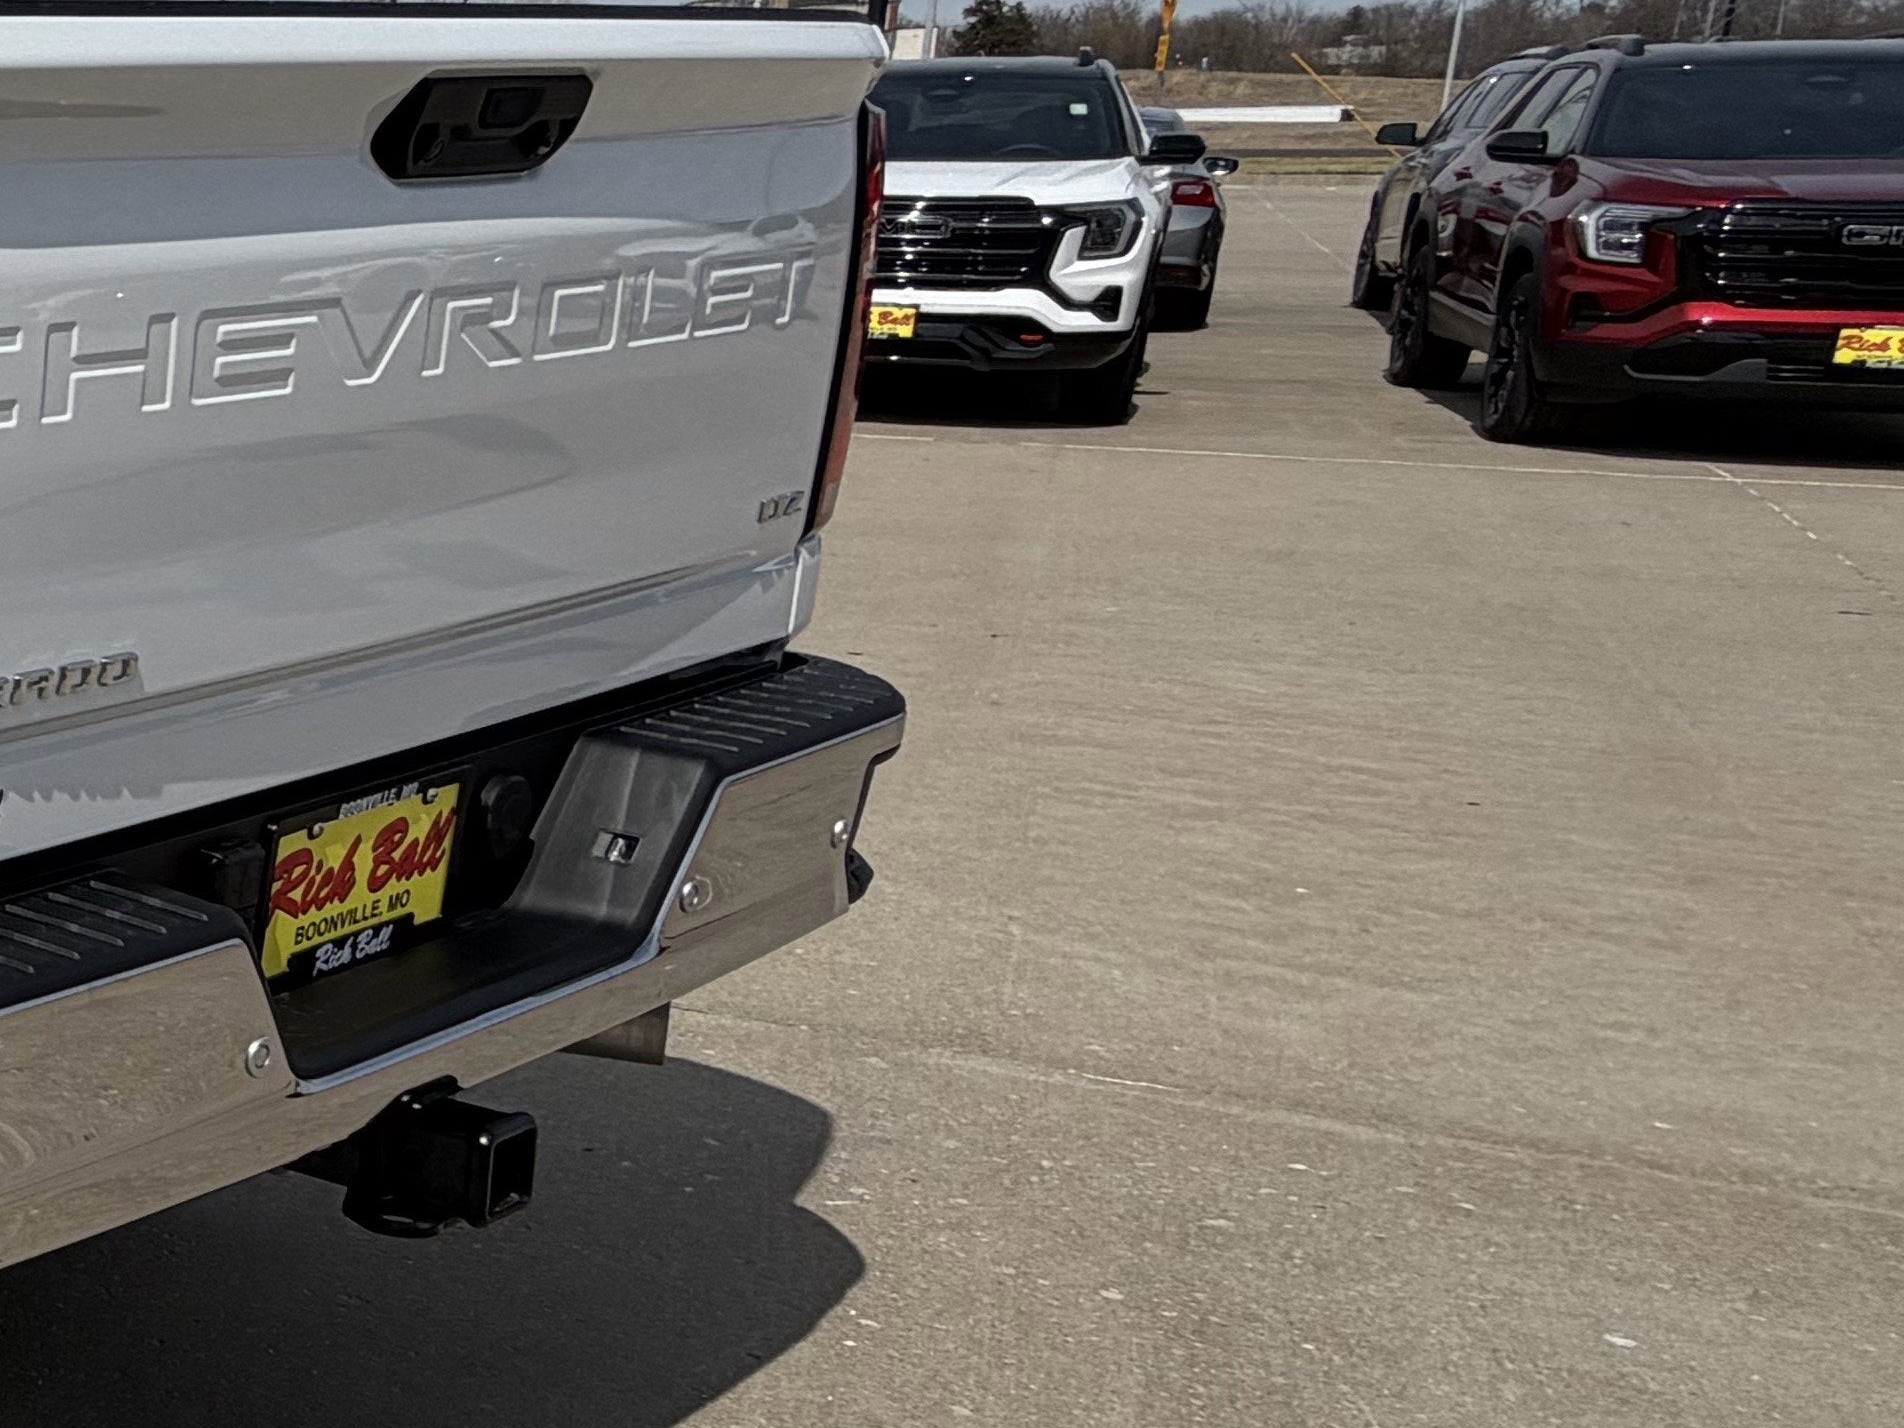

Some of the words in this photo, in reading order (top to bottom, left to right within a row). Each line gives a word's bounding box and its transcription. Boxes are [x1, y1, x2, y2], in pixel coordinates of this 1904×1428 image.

[269, 833, 362, 920] Rick
[367, 806, 457, 893] Ball
[294, 899, 383, 946] BOONVILLE,
[387, 889, 411, 912] MO
[313, 937, 353, 977] Rick
[355, 924, 393, 959] Ball
